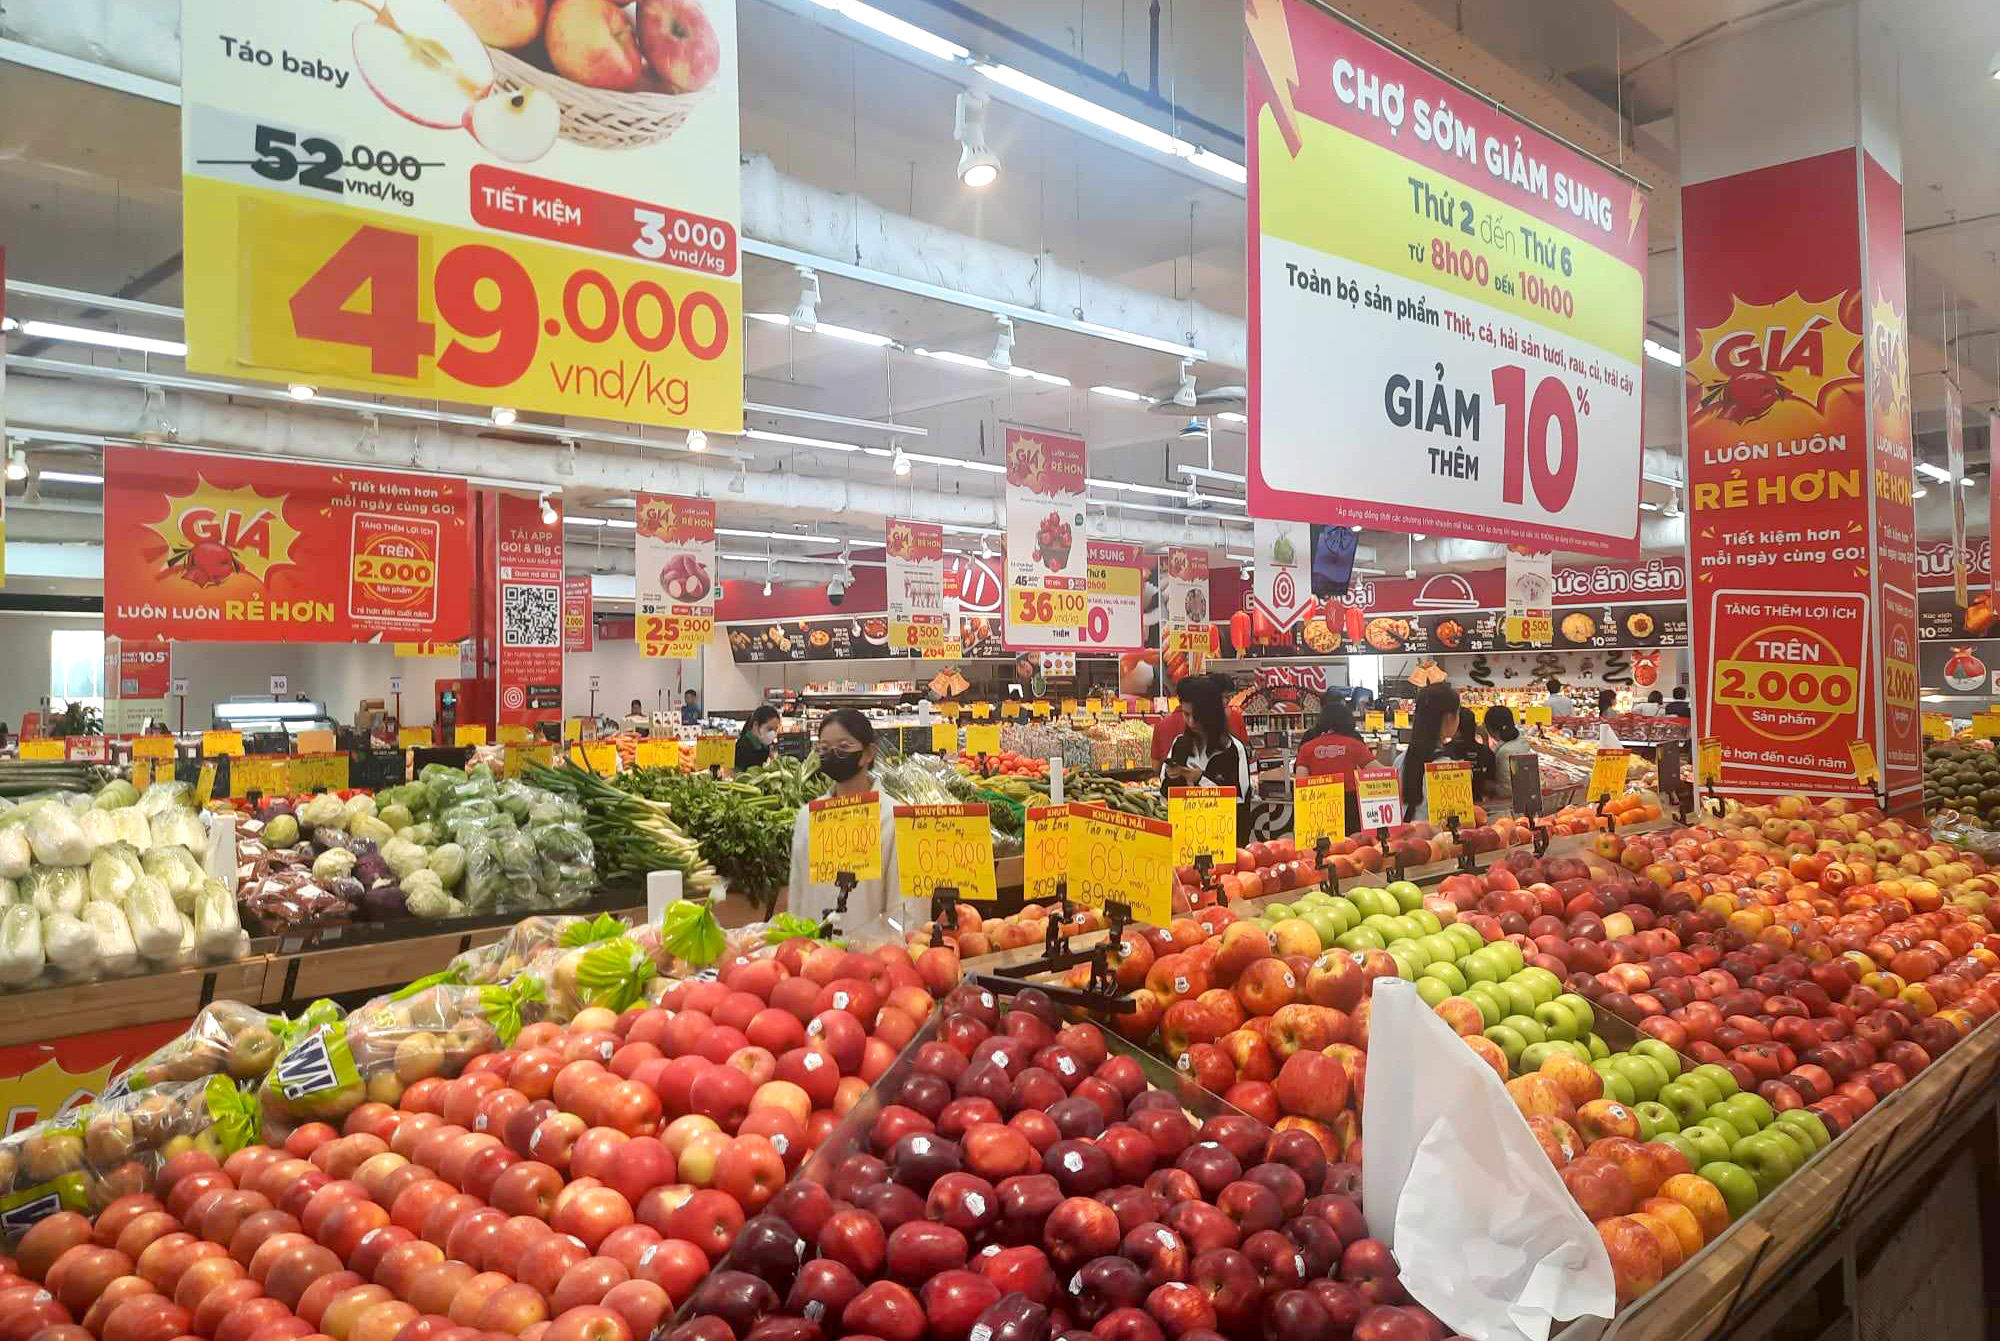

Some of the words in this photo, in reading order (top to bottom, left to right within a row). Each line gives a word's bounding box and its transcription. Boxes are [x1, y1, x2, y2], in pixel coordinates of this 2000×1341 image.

[219, 34, 273, 67] Táo
[282, 49, 349, 89] baby
[250, 124, 422, 194] 52.000
[1332, 58, 1406, 137] CHỢ
[1413, 98, 1477, 165] SỚM
[1484, 135, 1548, 202] GIẢM
[1554, 171, 1613, 233] SUNG
[345, 179, 414, 207] vnd/kg
[482, 186, 528, 214] TIẾT
[533, 196, 582, 227] KIỆM
[632, 208, 726, 260] 3.000
[1408, 176, 1454, 228] Thứ
[1460, 201, 1476, 236] 2
[1480, 214, 1516, 255] đến
[1520, 226, 1556, 266] Thứ
[1560, 245, 1573, 277] 6
[669, 247, 726, 273] vnd/kg
[1431, 238, 1489, 287] 8h00
[1494, 275, 1515, 297] ĐẾN
[1519, 271, 1574, 318] 10h00
[288, 225, 730, 389] 49.000
[1285, 262, 1331, 297] Toàn
[1336, 276, 1360, 309] bộ
[1364, 284, 1393, 314] sản
[1397, 295, 1440, 327] phẩm
[1444, 309, 1475, 342] Thịt,
[1478, 322, 1497, 349] cá,
[1500, 327, 1518, 352] hải
[1521, 334, 1540, 360] sản
[1542, 343, 1567, 372] tươi,
[1568, 356, 1587, 379] rau,
[1588, 359, 1602, 384] củ,
[1604, 366, 1619, 388] trái
[1619, 374, 1634, 397] cây
[1711, 314, 1833, 378] GIÁ
[549, 360, 689, 416] vnd/kg
[1384, 361, 1481, 443] GIẢM
[1428, 445, 1480, 482] THÊM
[1704, 438, 1769, 466] LUÔN
[1776, 433, 1847, 459] LUÔN
[349, 481, 376, 494] Tiết
[379, 484, 411, 498] kiệm
[414, 487, 438, 499] hơn
[1694, 469, 1749, 511] RẺ
[1757, 467, 1861, 506] HƠN
[331, 494, 356, 508] mỗi
[360, 500, 392, 512] ngày
[397, 501, 428, 515] cùng
[431, 504, 456, 516] GO!
[178, 508, 282, 560] GIÁ
[531, 532, 553, 541] APP
[1723, 530, 1755, 546] Tiết
[1760, 530, 1801, 547] kiệm
[1807, 529, 1841, 541] hơn
[378, 543, 416, 558] TRÊN
[524, 543, 532, 554] &
[534, 544, 552, 557] Big
[554, 546, 563, 556] C
[1099, 550, 1125, 563] SUNG
[1701, 550, 1731, 566] mỗi
[1736, 551, 1777, 567] ngày
[1783, 549, 1826, 564] cùng
[1831, 547, 1866, 561] GO!
[357, 560, 432, 583] 2.000
[1101, 569, 1106, 579] 6
[1594, 567, 1627, 592] ăn
[1633, 560, 1681, 590] sẵn
[117, 603, 167, 620] LUÔN
[172, 604, 221, 621] LUÔN
[225, 592, 265, 622] RẺ
[270, 600, 335, 622] HƠN
[1019, 591, 1085, 622] 36.100
[1725, 602, 1761, 616] TĂNG
[1764, 603, 1801, 618] THÊM
[1805, 605, 1828, 620] LỢI
[1832, 605, 1857, 620] ÍCH
[645, 616, 711, 643] 25.900
[1052, 629, 1071, 639] THÊM
[1521, 619, 1550, 640] 8.500
[1755, 638, 1820, 662] TRÊN
[1719, 667, 1854, 708] 2.000
[1752, 709, 1777, 724] Sản
[1779, 711, 1817, 728] phẩm
[1734, 748, 1758, 762] hơn
[1760, 750, 1785, 764] đến
[1787, 752, 1815, 767] cuối
[1818, 756, 1848, 771] năm
[914, 803, 948, 817] KHUYẾN
[948, 803, 965, 816] MÃI
[1092, 809, 1128, 828] KHUYẾN
[1128, 816, 1146, 830] MÃI
[917, 838, 986, 876] 65.000
